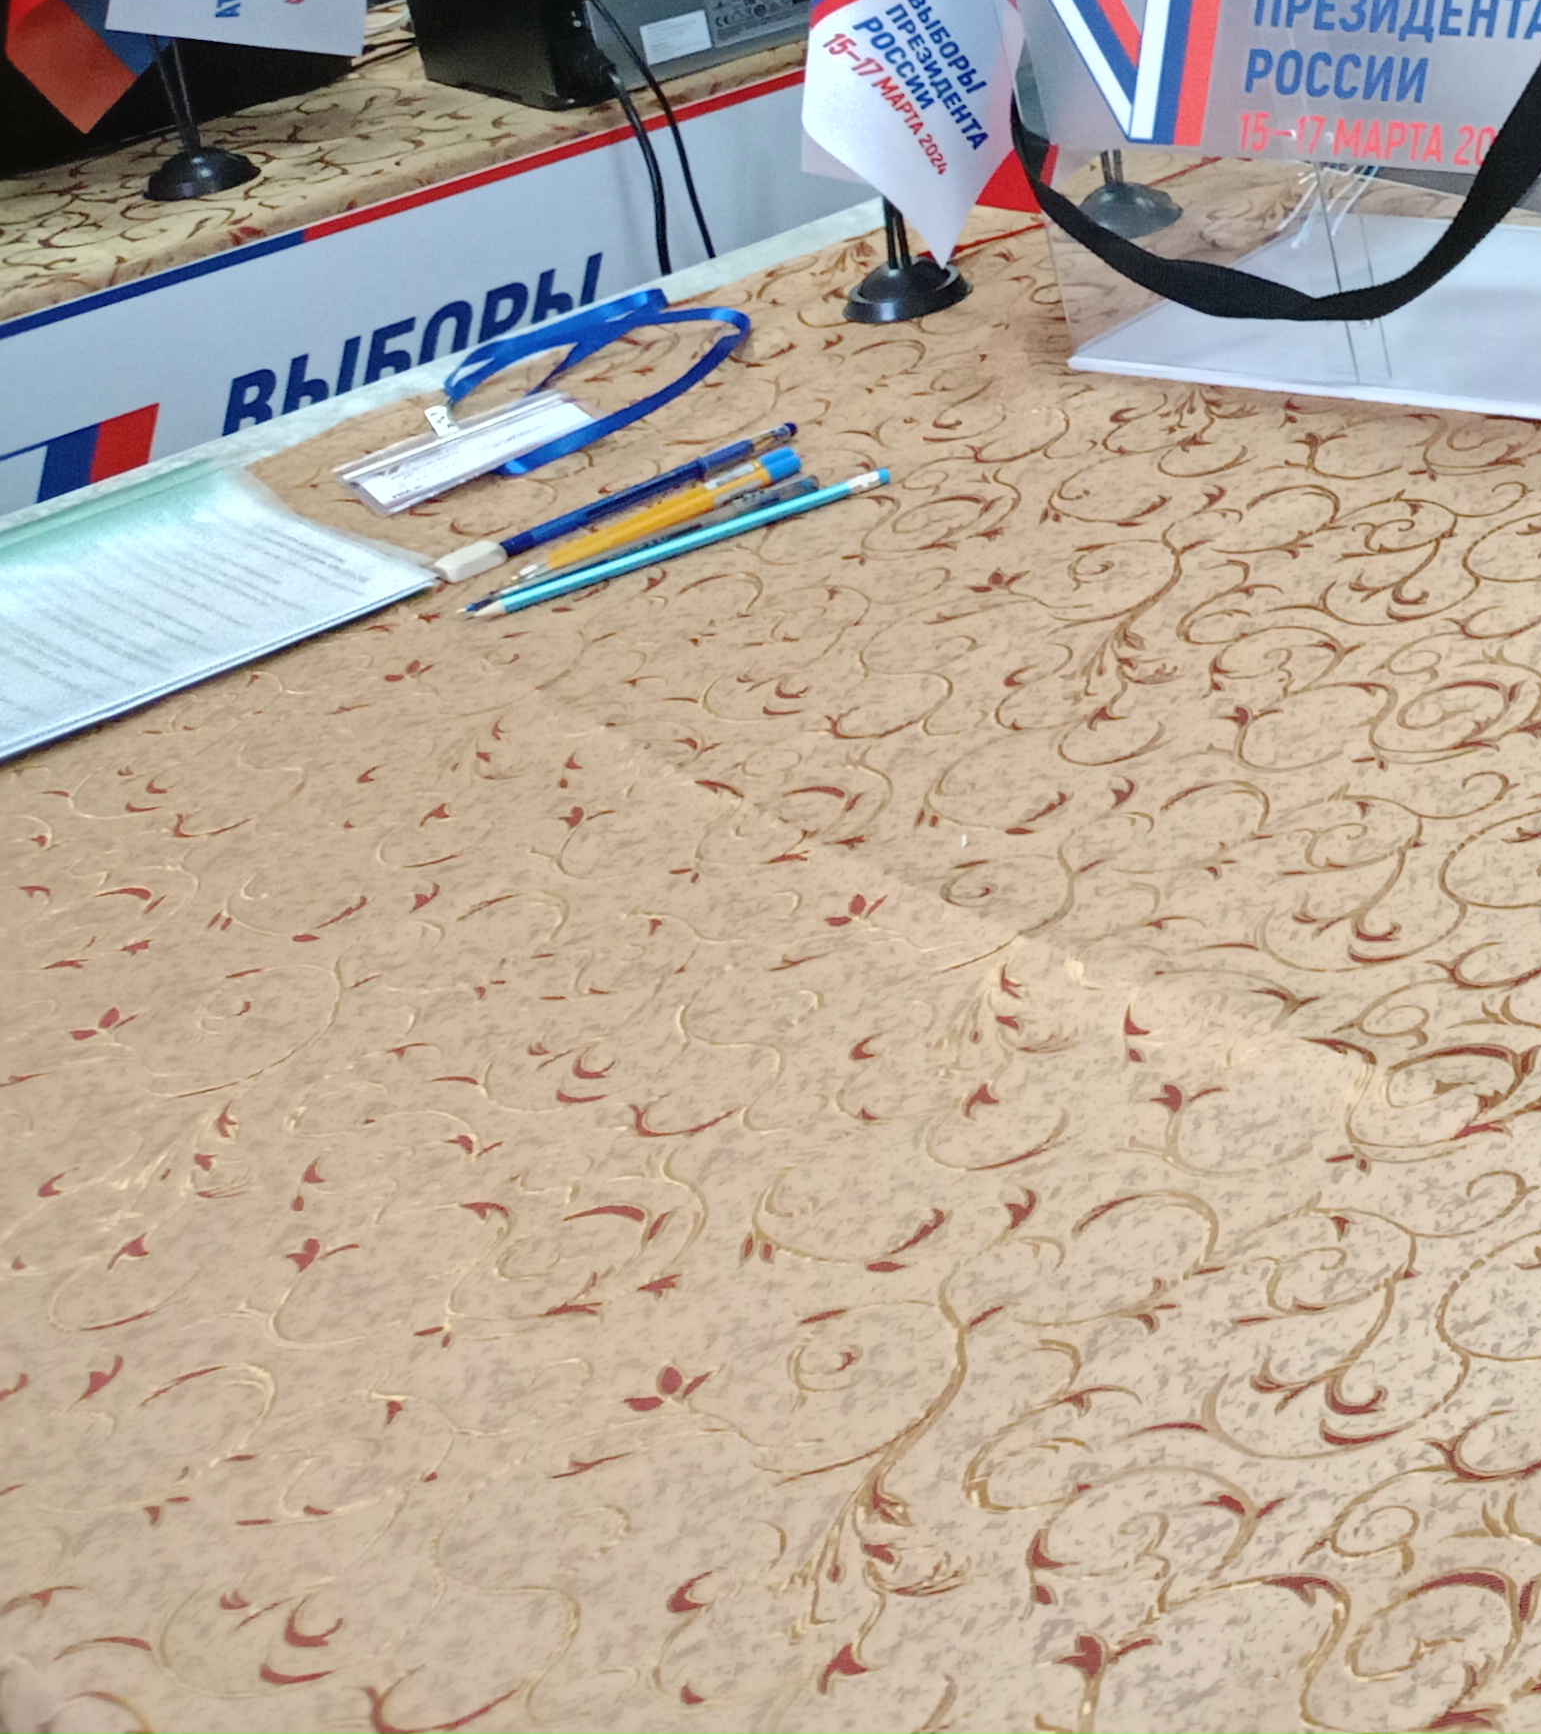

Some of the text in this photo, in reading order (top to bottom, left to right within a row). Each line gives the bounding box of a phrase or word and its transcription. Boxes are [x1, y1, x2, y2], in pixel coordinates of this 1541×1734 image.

[852, 16, 935, 110] РОССИИ
[885, 3, 989, 150] ПРЕЗИДЕНТА
[1244, 48, 1429, 104] РОССИИ
[871, 75, 924, 135] МАРТА
[917, 133, 948, 175] 2024
[1332, 118, 1444, 164] МАРТА
[222, 252, 603, 436] ВЫБОРЫ
